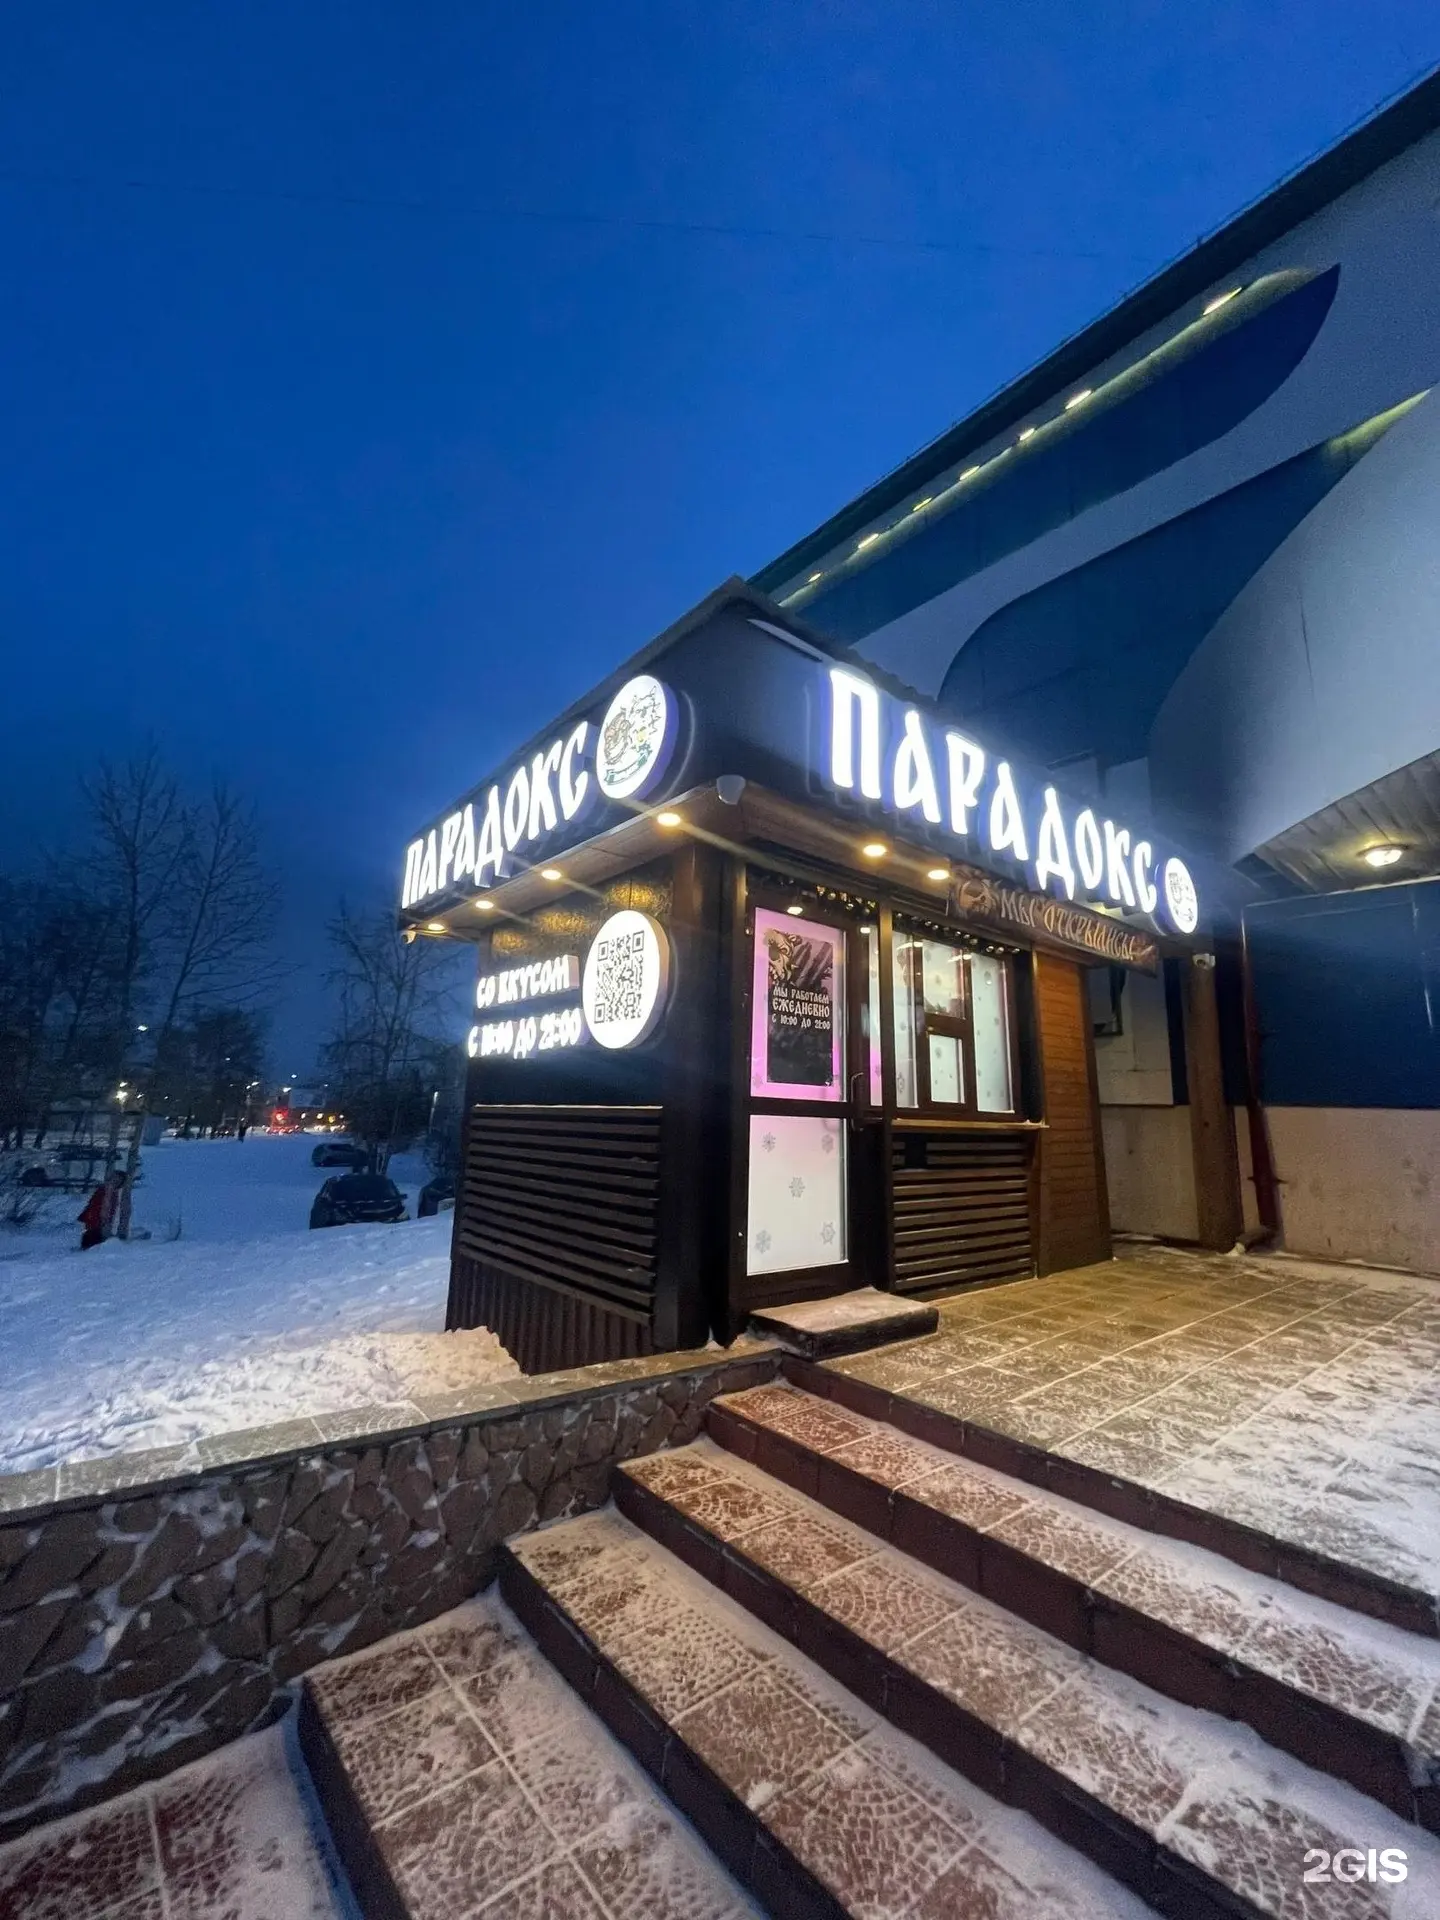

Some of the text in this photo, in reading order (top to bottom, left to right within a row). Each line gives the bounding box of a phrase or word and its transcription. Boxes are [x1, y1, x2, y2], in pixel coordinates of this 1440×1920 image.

[830, 668, 1158, 914] ПАРАДОКС
[401, 720, 589, 909] ПАРАДОКС
[1001, 889, 1036, 928] МЫ
[476, 954, 570, 1009] СО ВКУСОМ
[773, 986, 829, 1004] МЫ РАБОТАЕМ
[771, 1013, 777, 1023] С
[800, 1017, 812, 1029] ДО
[772, 997, 830, 1018] ЕЖЕДНЕВНО
[467, 1026, 479, 1058] С
[513, 1016, 537, 1060] ДО
